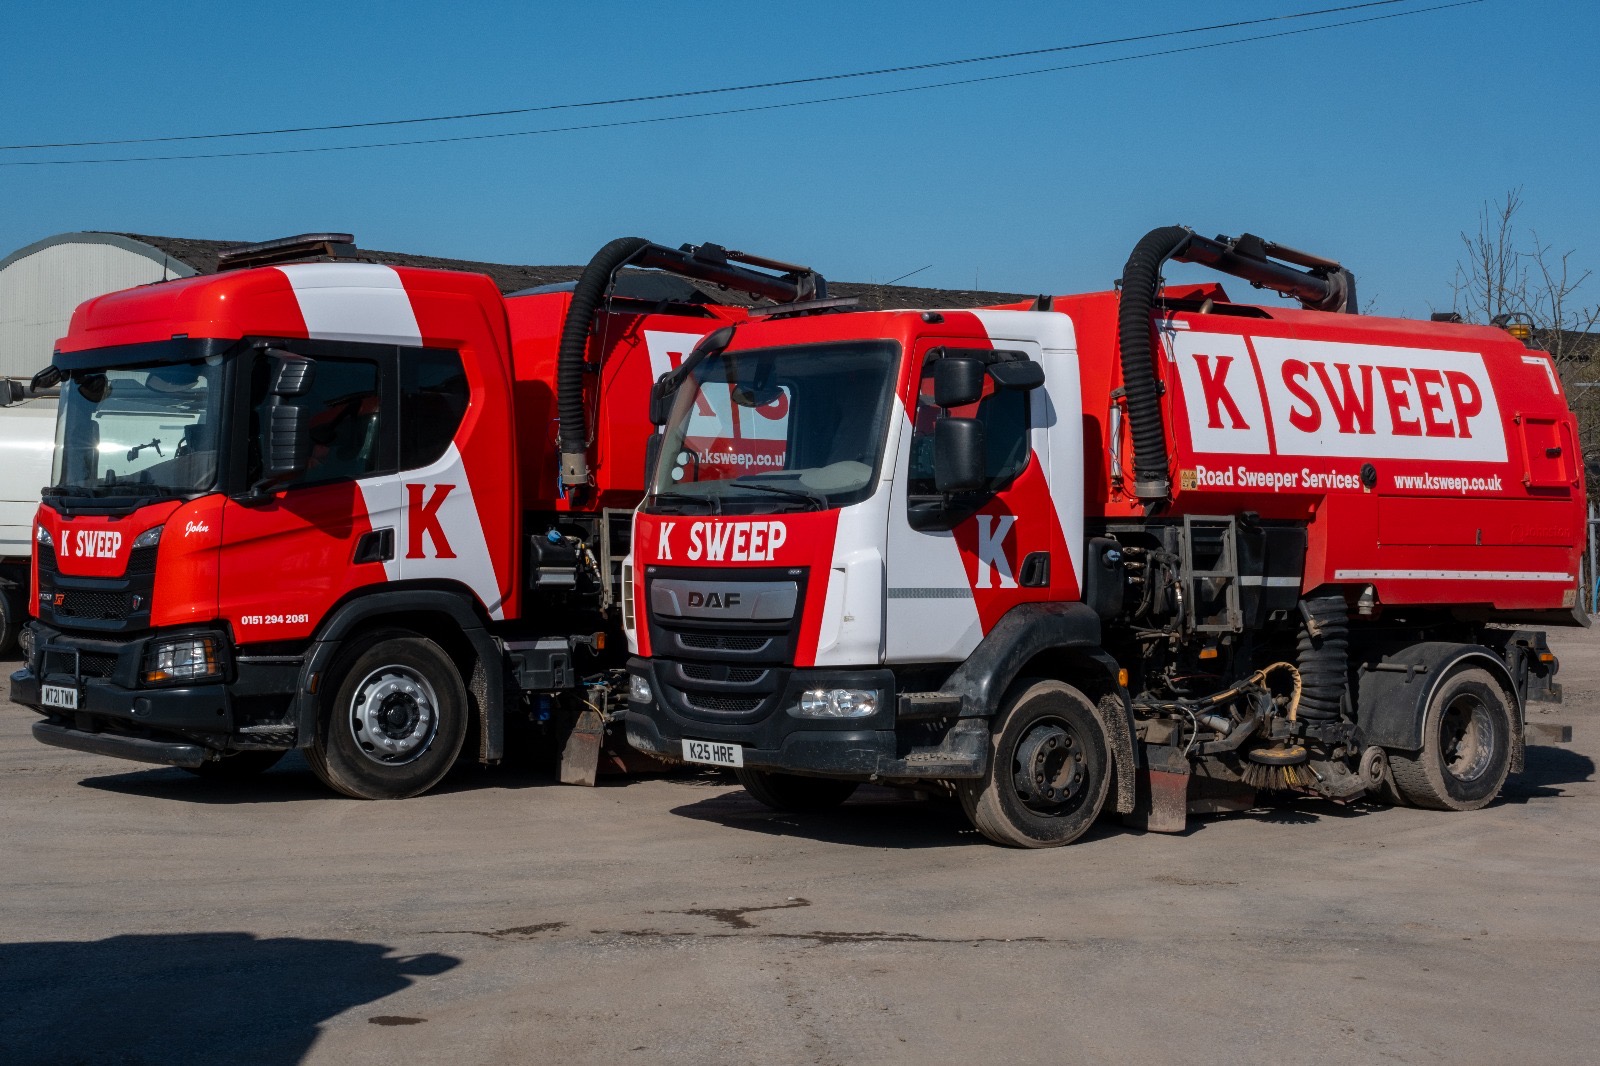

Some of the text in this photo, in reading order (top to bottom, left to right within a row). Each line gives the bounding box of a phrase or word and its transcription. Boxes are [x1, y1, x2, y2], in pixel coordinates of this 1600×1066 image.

[1192, 354, 1482, 438] K SWEEP
[1195, 465, 1360, 492] Road Sweeper Services
[1394, 472, 1502, 494] www.ksweep.co.uk
[185, 521, 209, 537] John
[406, 484, 457, 558] K
[60, 530, 121, 558] K SWEEP
[657, 521, 787, 561] K SWEEP
[975, 515, 1018, 588] K
[688, 592, 740, 608] DAF
[241, 614, 309, 625] 0151 294 2081
[690, 743, 735, 763] K25 HRE
